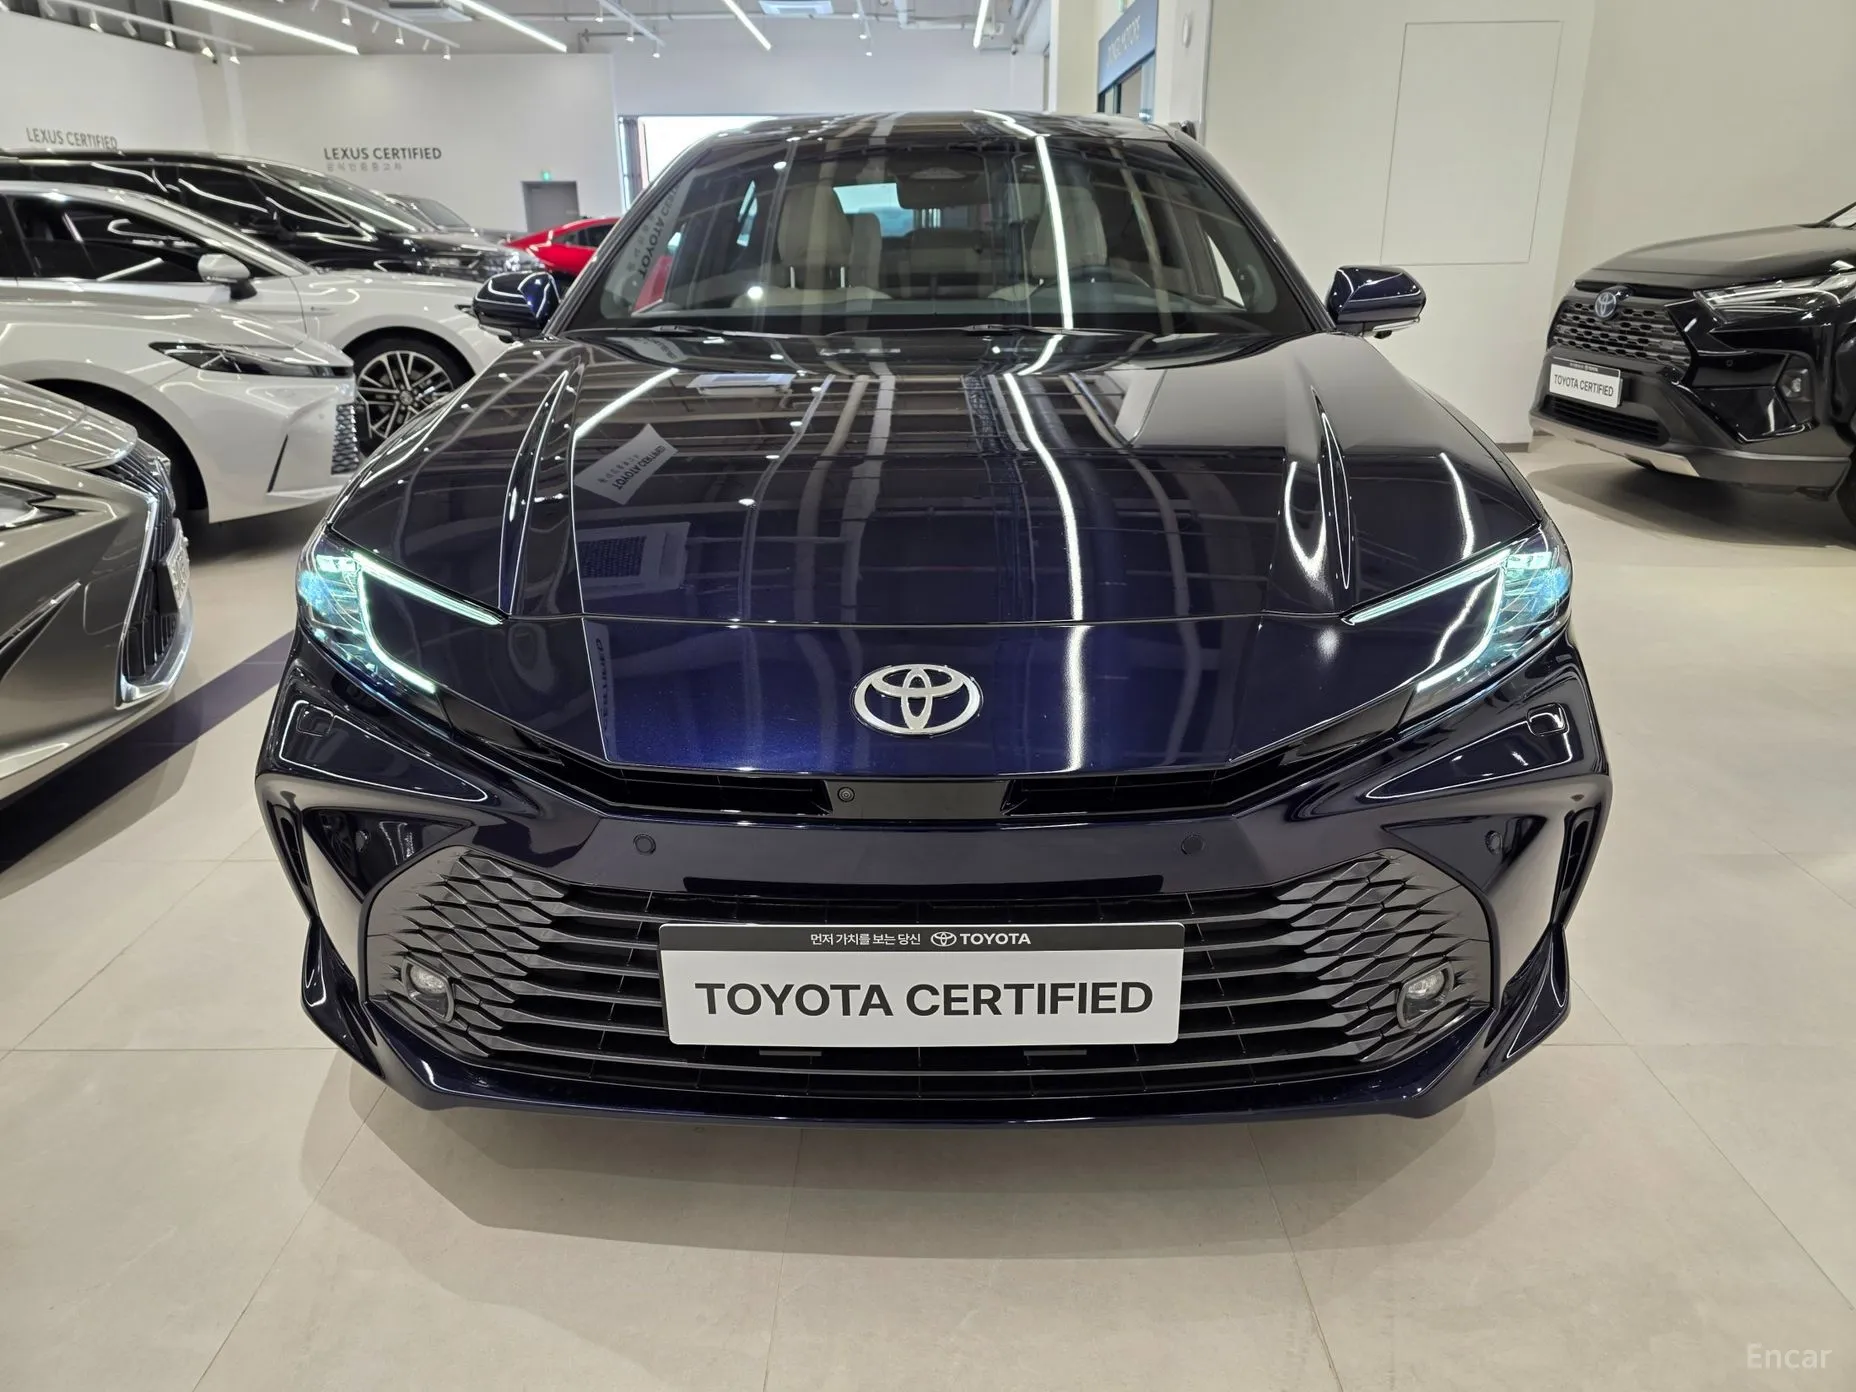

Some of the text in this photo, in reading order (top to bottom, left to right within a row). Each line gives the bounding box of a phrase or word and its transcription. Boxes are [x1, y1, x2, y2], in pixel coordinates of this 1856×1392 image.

[25, 127, 118, 151] LEXUS CERTIFIED
[323, 147, 442, 160] LEXUS CERTIFIED
[1554, 374, 1614, 397] TOYOTA CERTIFIED
[810, 933, 1031, 945] 먼저 가치를 보는 당신 TOYOTA
[695, 981, 1153, 1017] TOYOTA CERTIFIED
